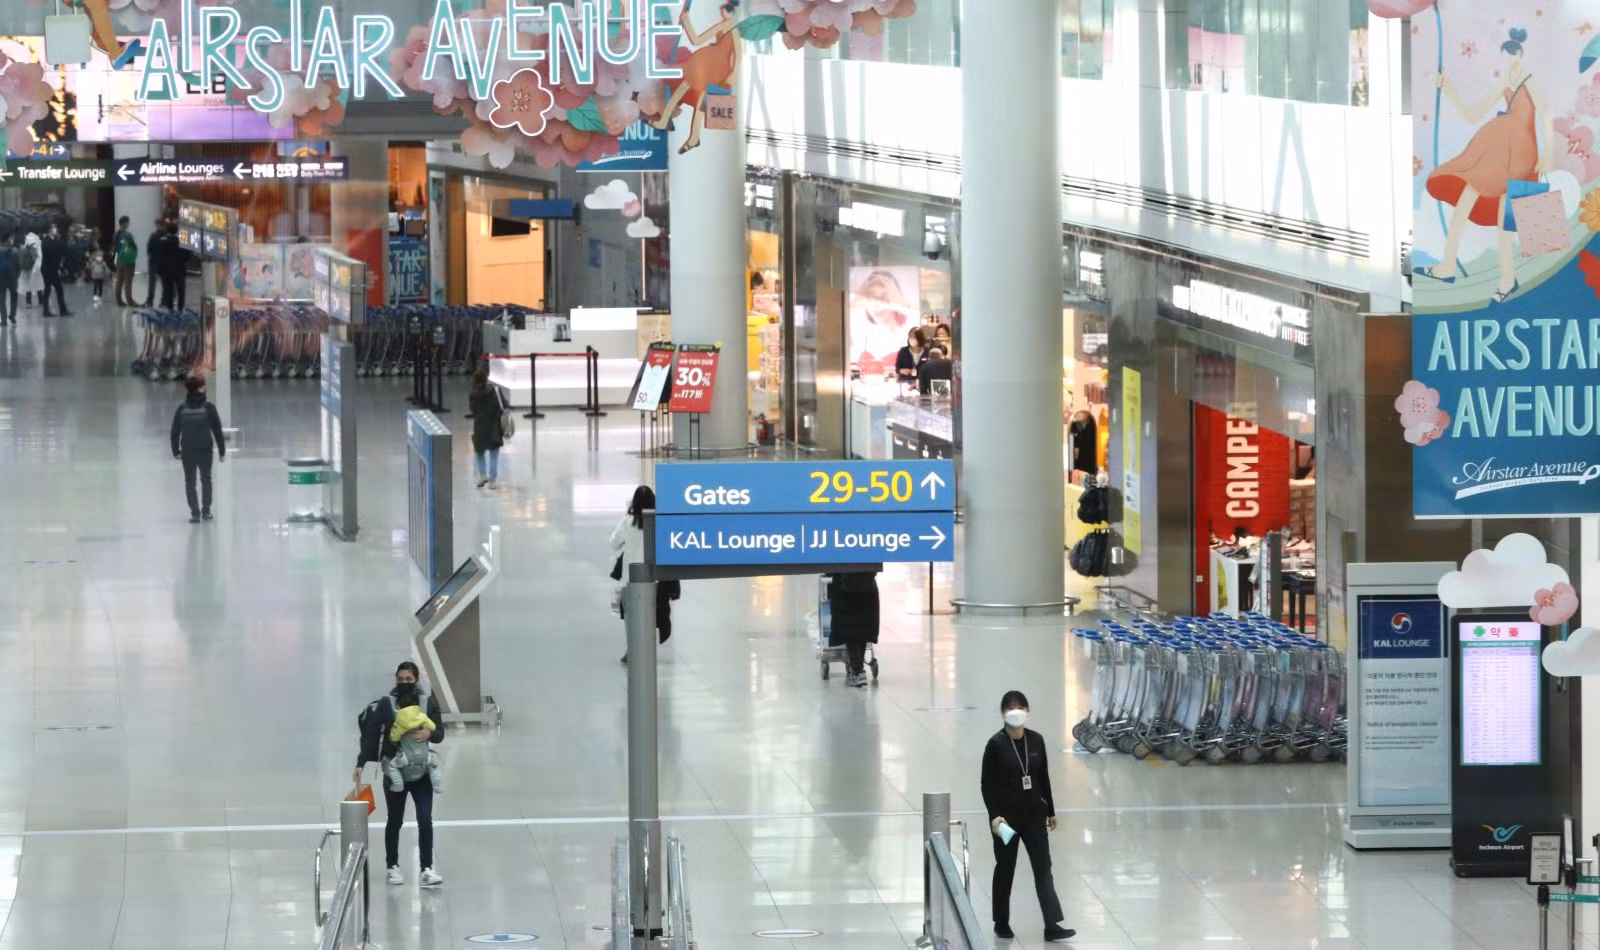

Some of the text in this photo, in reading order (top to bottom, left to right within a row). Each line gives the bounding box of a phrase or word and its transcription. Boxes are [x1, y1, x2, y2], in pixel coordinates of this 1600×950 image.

[422, 0, 684, 100] AVENUE
[710, 106, 733, 119] SALE
[17, 165, 106, 182] Transfer Lounge
[139, 162, 225, 176] Airline Lounges
[1451, 385, 1600, 438] AVENU
[1225, 401, 1260, 518] CAMPER
[1452, 456, 1587, 485] Airstar Avenue
[684, 470, 913, 506] Gates 29-50
[670, 529, 911, 553] KAL Lounge JJ Lounge
[1373, 639, 1430, 648] KAL LOUNGE
[1490, 627, 1501, 638] 약
